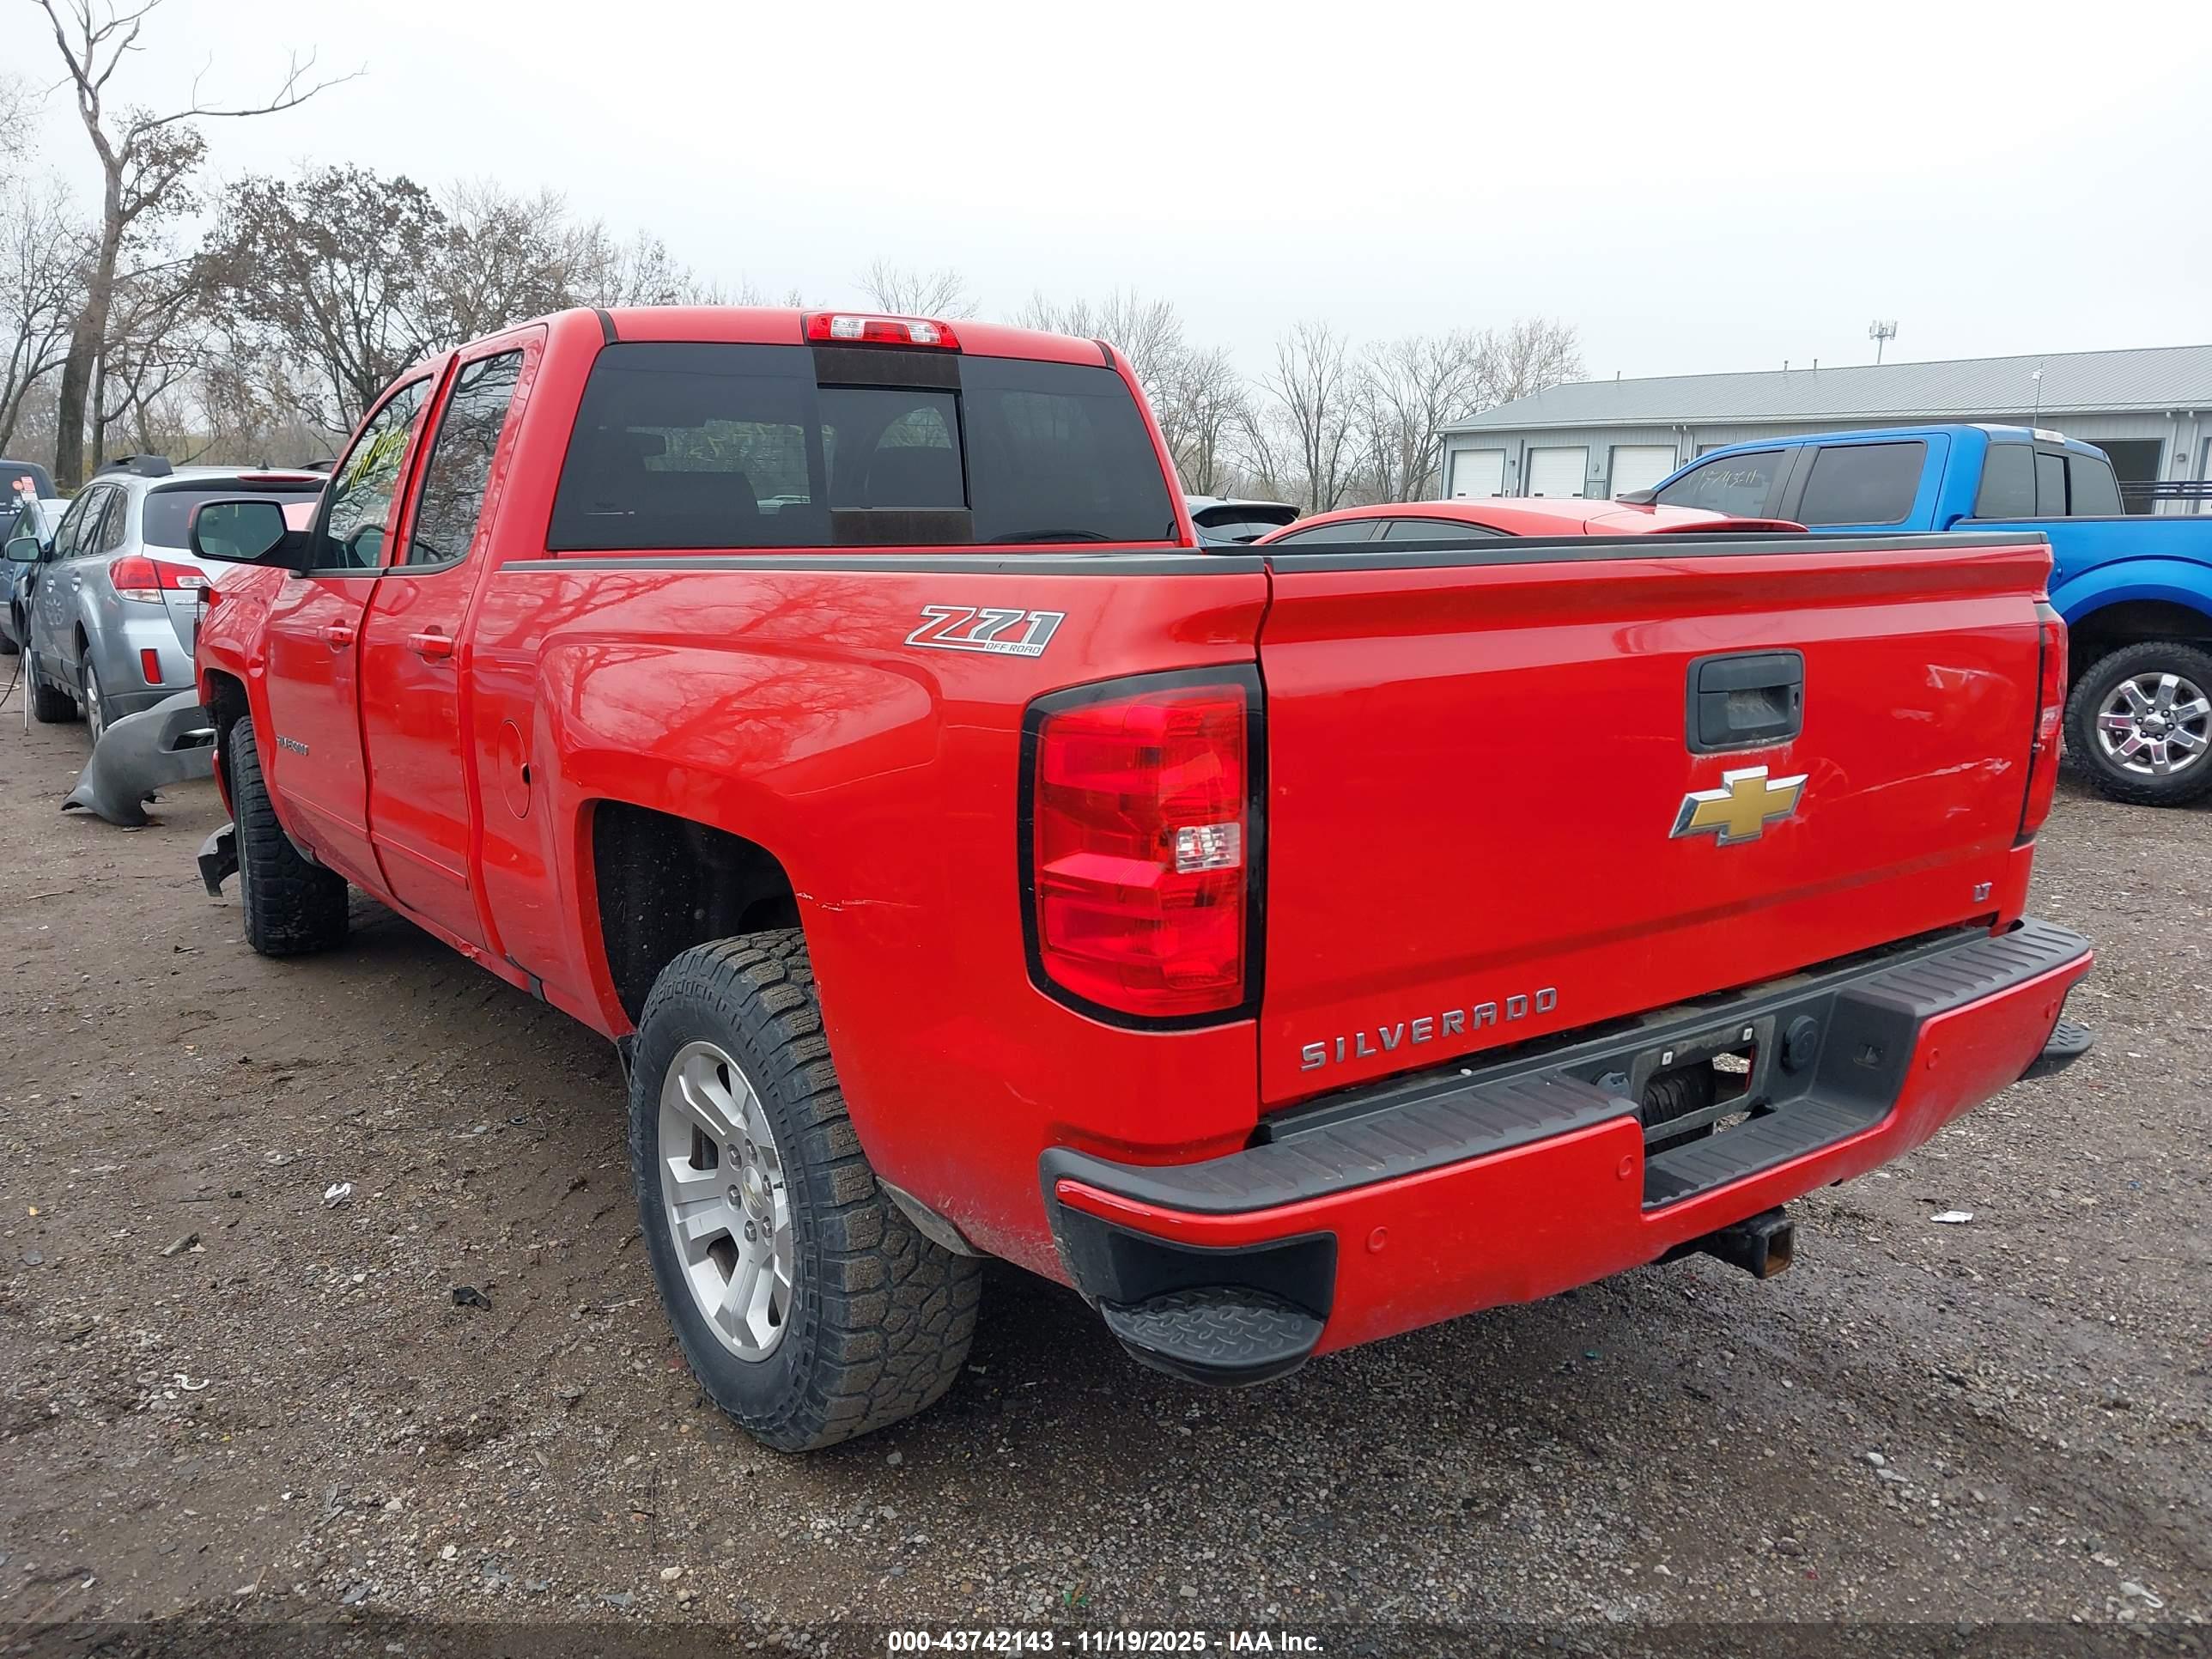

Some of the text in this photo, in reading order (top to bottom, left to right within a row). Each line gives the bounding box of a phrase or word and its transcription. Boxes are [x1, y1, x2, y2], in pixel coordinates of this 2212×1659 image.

[904, 605, 1066, 655] Z71
[987, 642, 1041, 654] OFF ROAD
[1301, 988, 1558, 1072] SILVERADO
